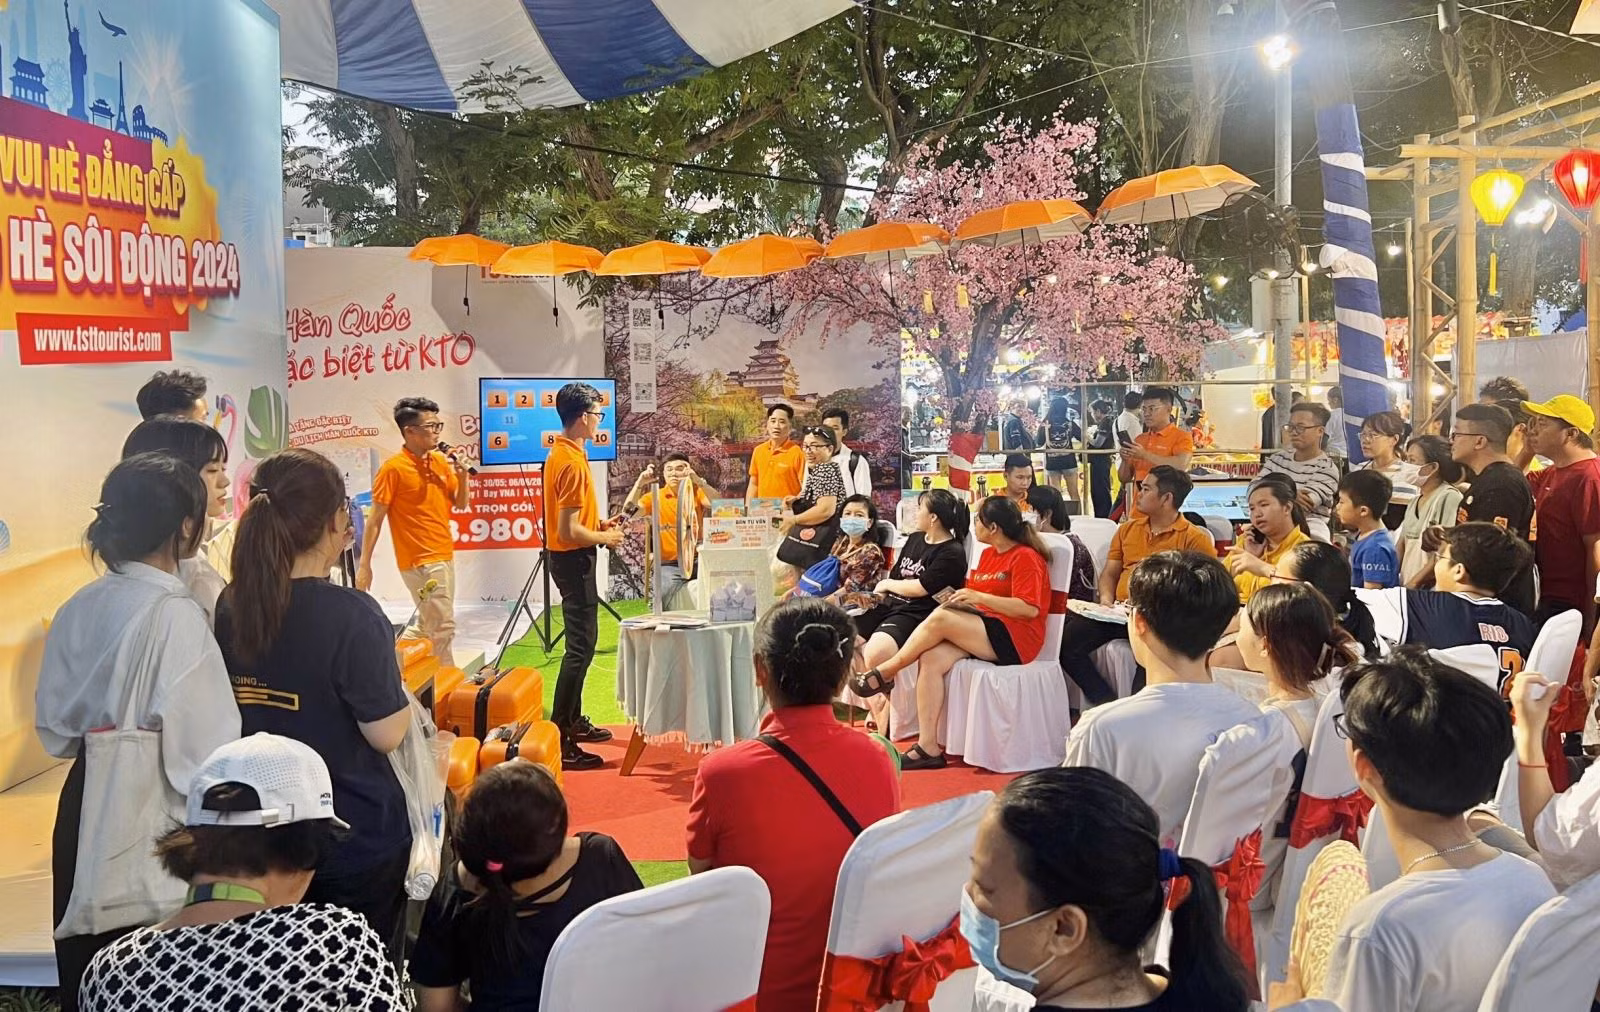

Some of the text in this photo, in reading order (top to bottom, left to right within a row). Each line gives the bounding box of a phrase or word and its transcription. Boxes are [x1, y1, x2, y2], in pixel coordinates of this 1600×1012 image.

[0, 135, 185, 213] VUI HÈ ĐẲNG CẤP
[9, 207, 240, 298] HÈ SÔI ĐỘNG 2024
[286, 293, 412, 343] Hàn Quốc
[33, 326, 162, 352] www.tsttourist.com
[287, 331, 477, 388] ặc biệt từ KTO
[521, 395, 527, 404] 2
[547, 394, 553, 404] 3
[505, 415, 514, 424] 11
[363, 428, 379, 437] KTO
[494, 433, 608, 446] 6 8 10
[500, 488, 516, 497] VNA
[474, 504, 508, 516] TRỌN
[1478, 623, 1509, 643] RIO
